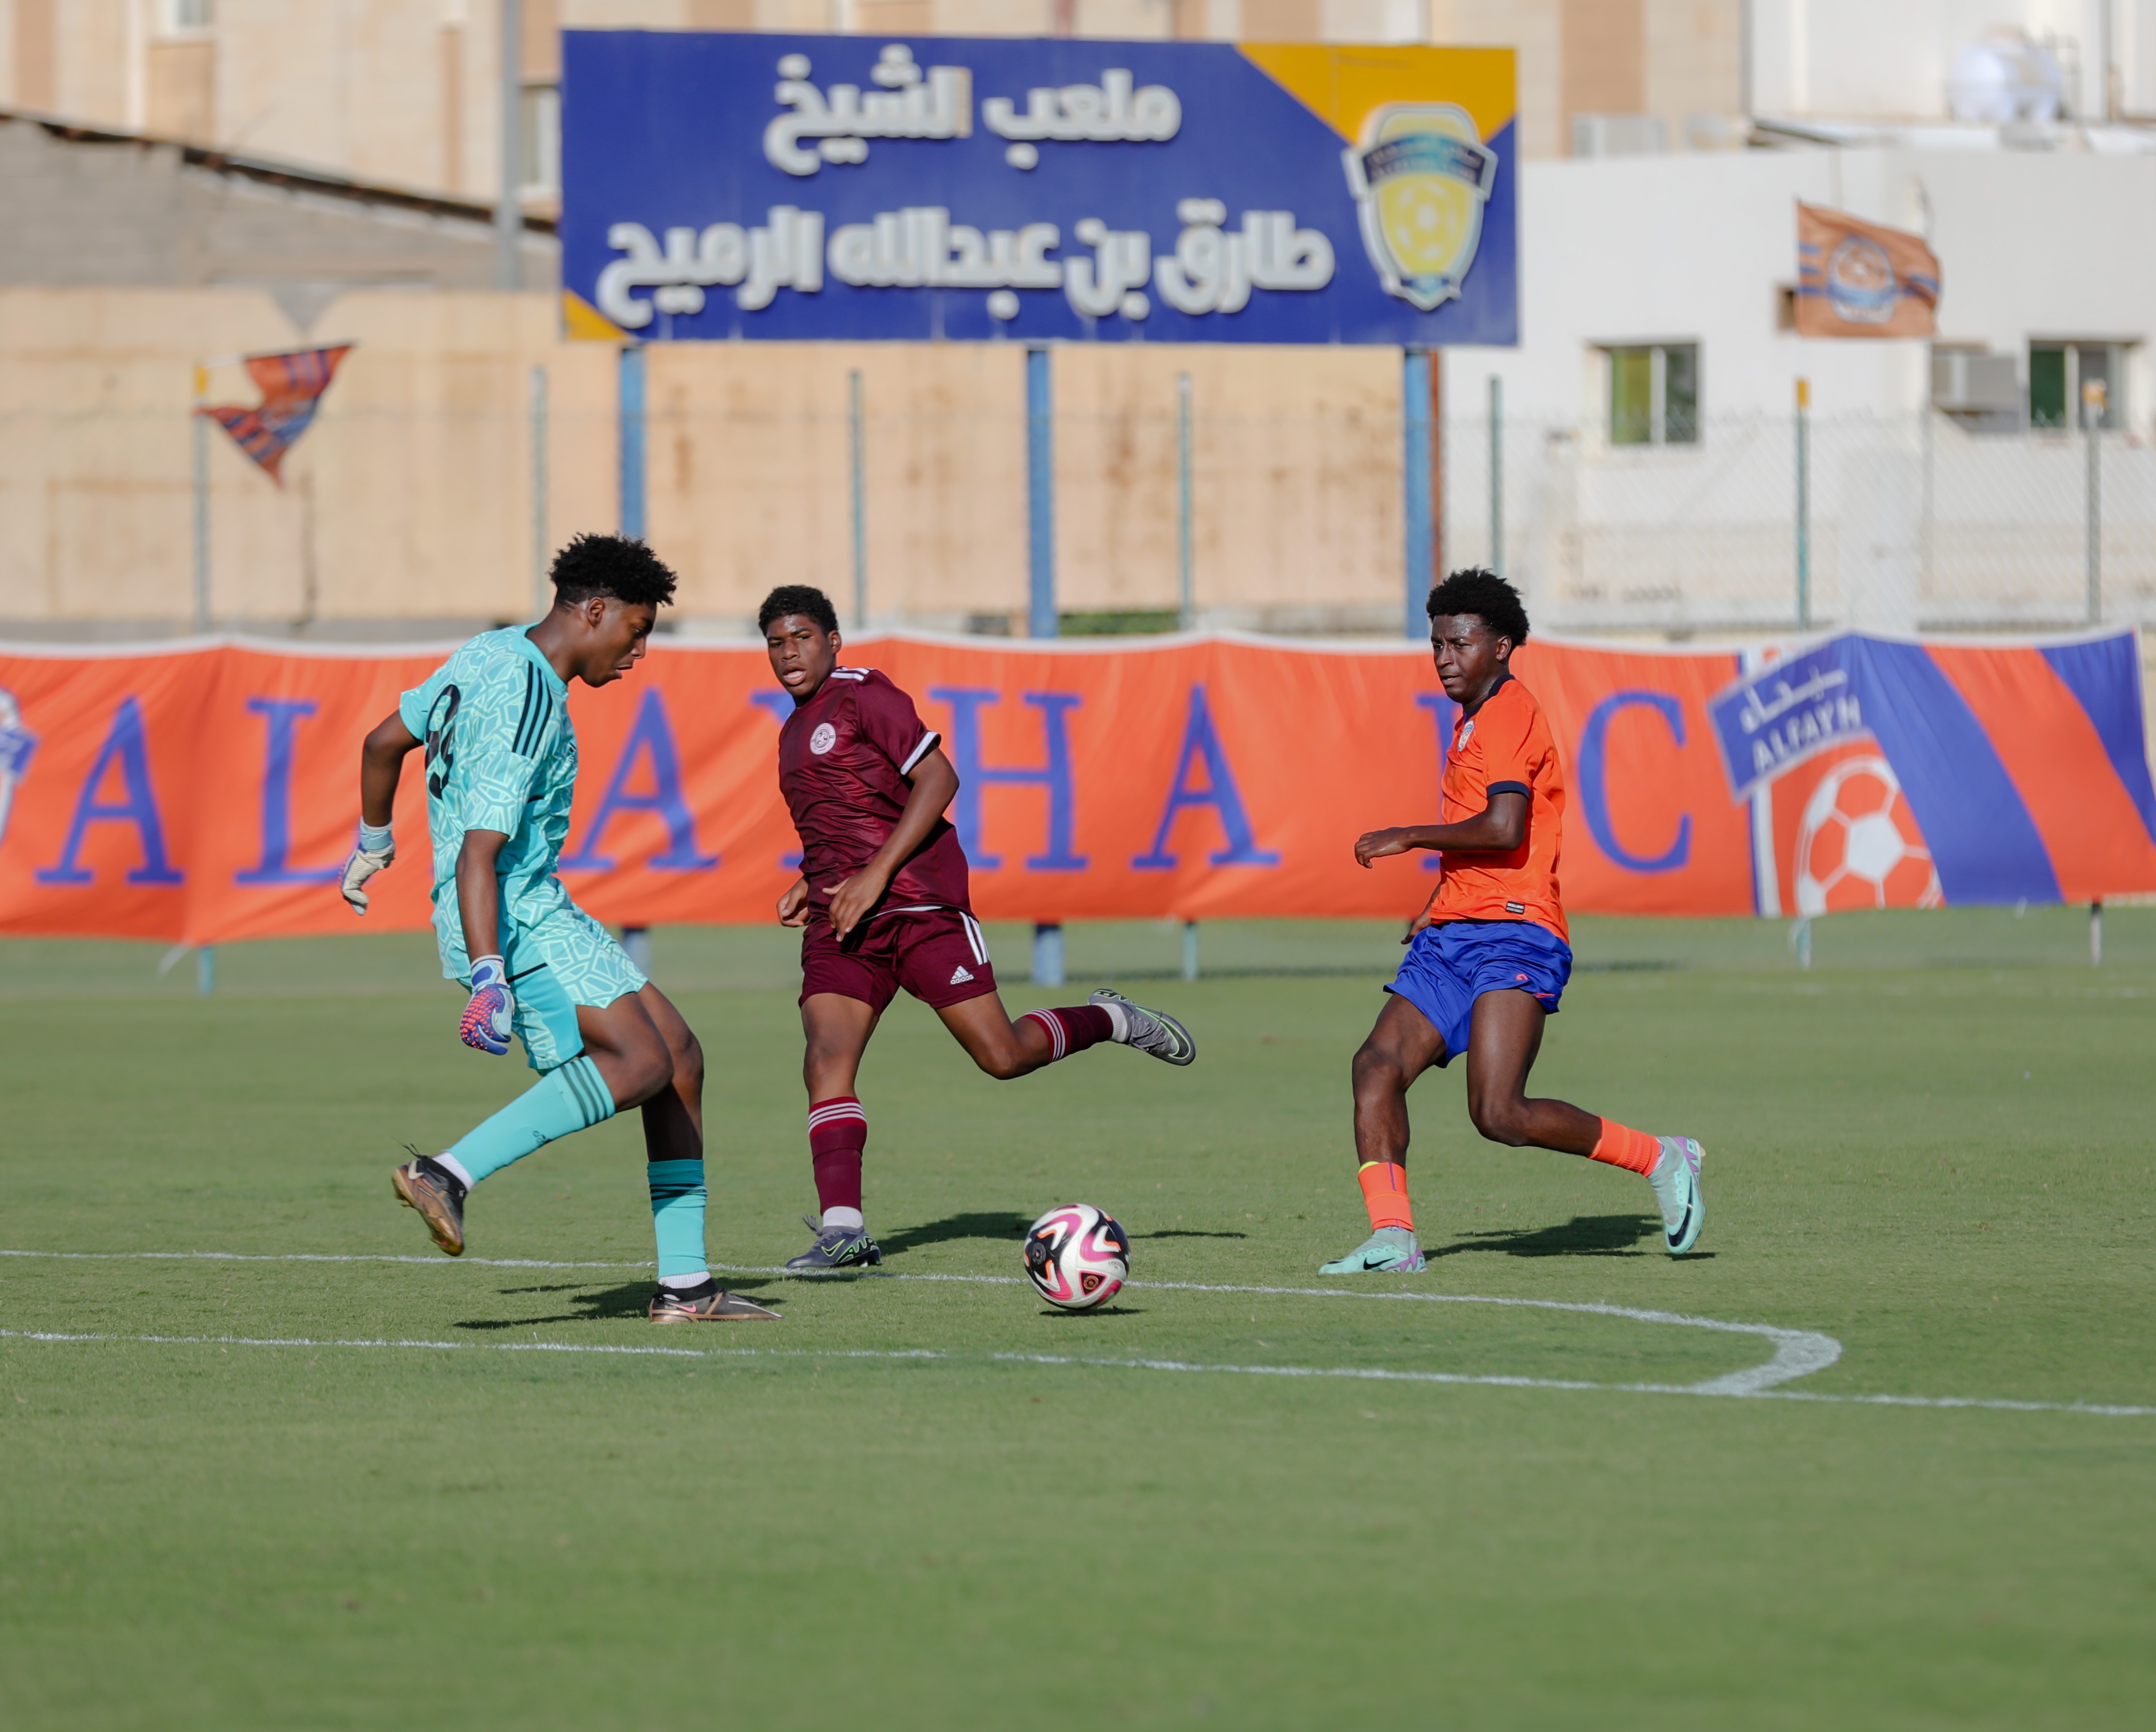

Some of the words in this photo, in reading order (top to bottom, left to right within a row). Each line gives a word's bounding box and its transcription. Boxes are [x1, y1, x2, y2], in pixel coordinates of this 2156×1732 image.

[763, 44, 972, 176] الشيخ
[981, 68, 1182, 170] ملعب
[595, 205, 824, 329] الرميح
[826, 206, 1062, 320] عبدالله
[1063, 217, 1151, 321] بن
[1154, 197, 1335, 315] طارق
[950, 974, 974, 985] adidas
